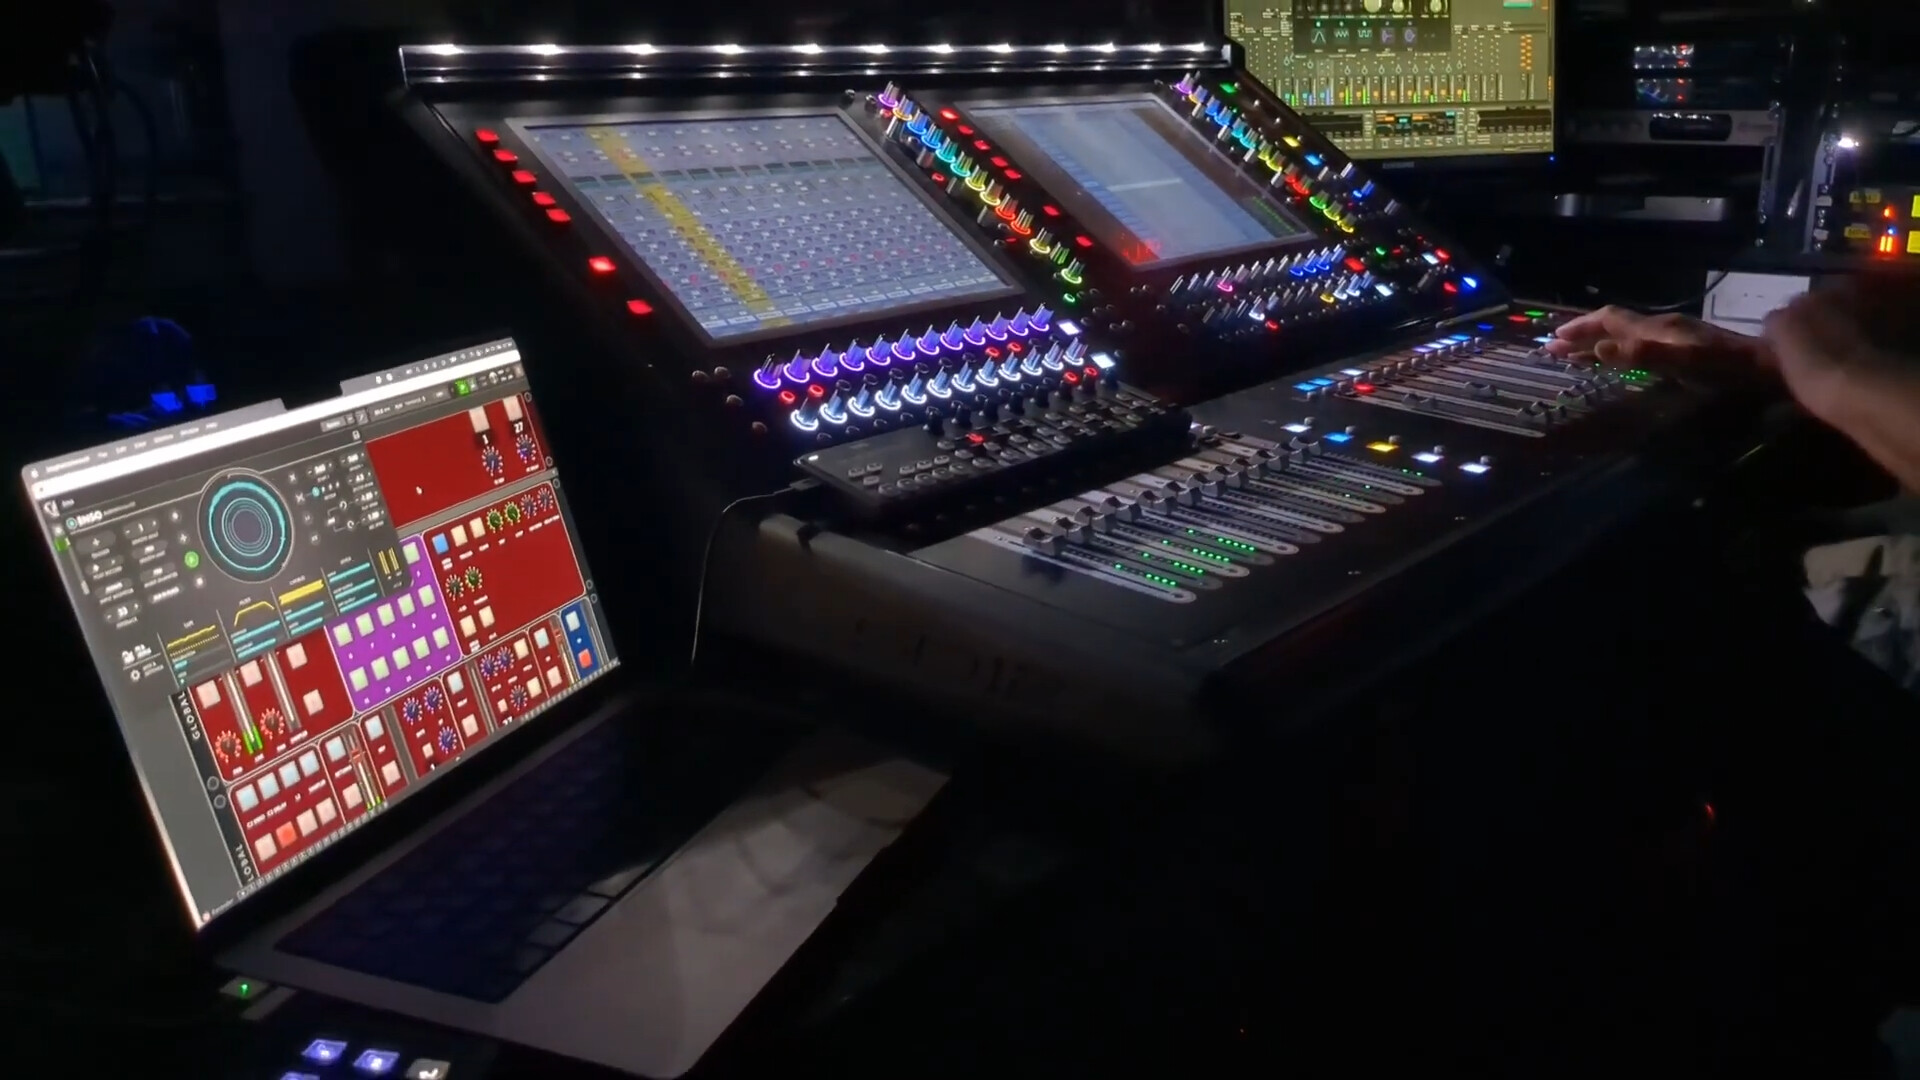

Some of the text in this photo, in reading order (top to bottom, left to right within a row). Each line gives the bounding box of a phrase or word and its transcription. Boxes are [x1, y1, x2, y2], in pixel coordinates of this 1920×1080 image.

[514, 421, 524, 434] 27
[482, 434, 489, 445] 1
[76, 510, 103, 528] ENSO
[177, 691, 201, 740] GLOBAL
[235, 843, 254, 882] LOBAL
